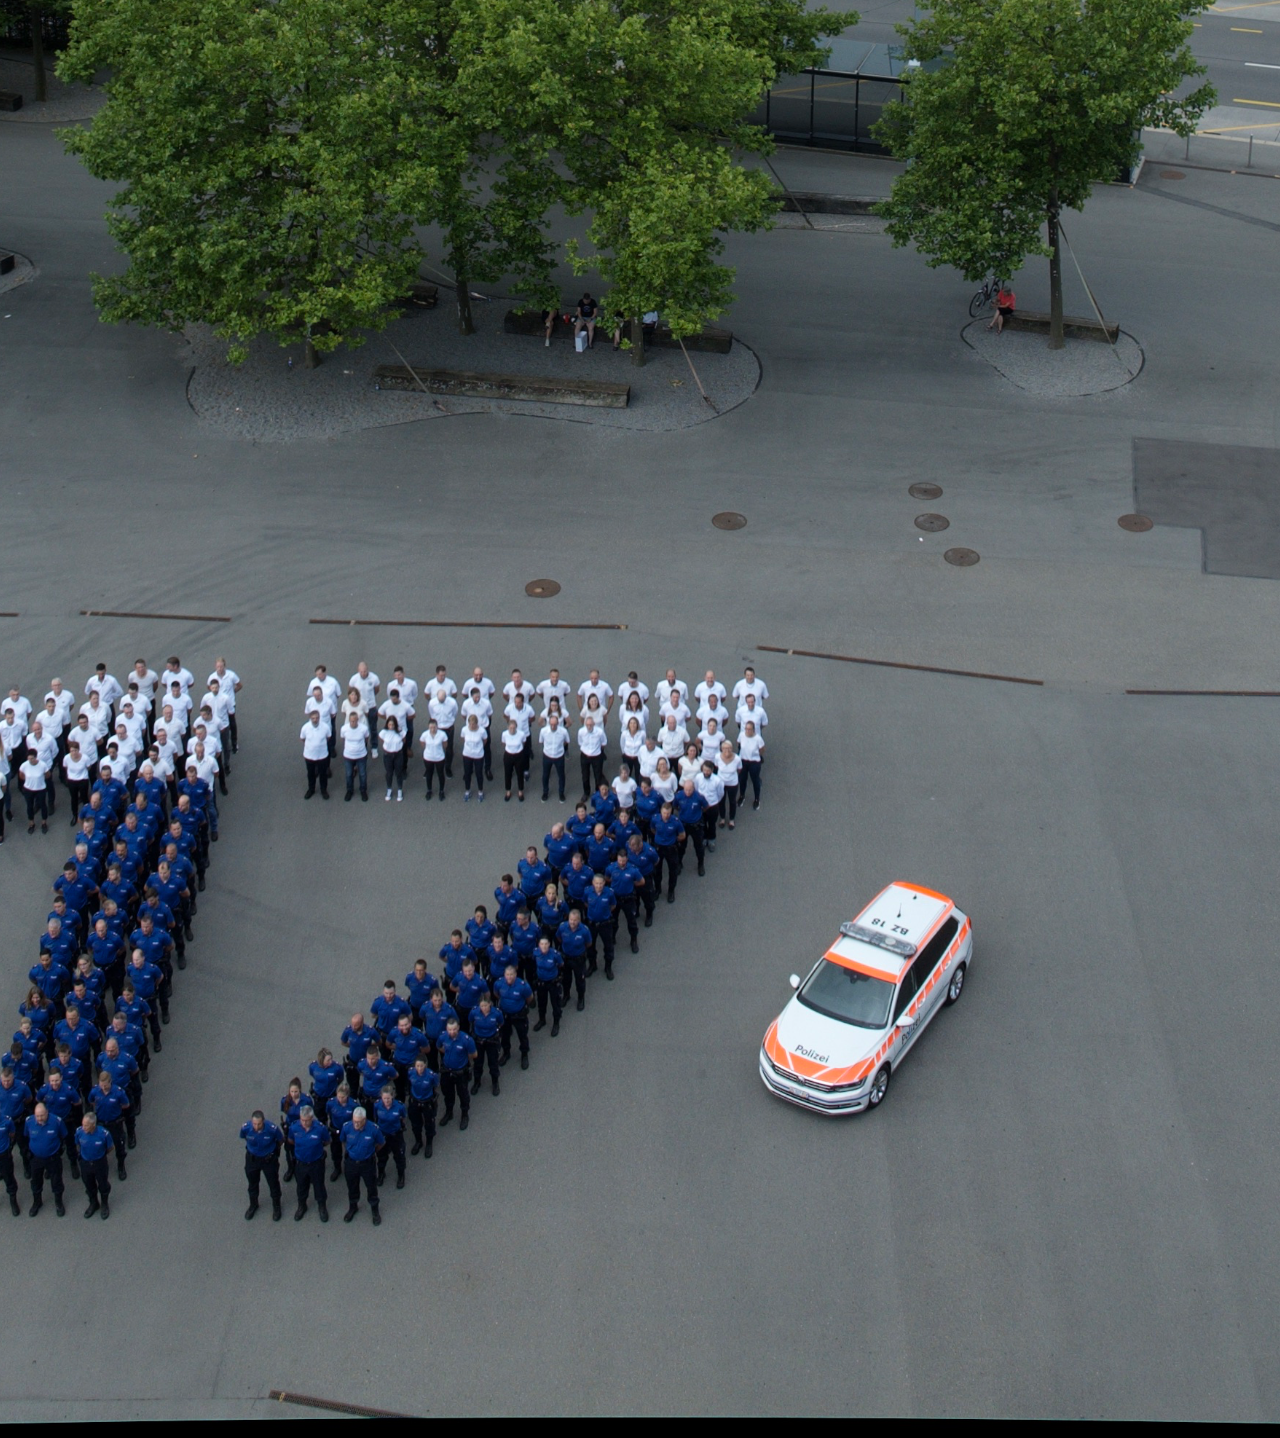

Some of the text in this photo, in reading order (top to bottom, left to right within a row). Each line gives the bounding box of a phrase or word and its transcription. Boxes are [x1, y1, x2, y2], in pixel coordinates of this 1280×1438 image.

[871, 918, 909, 936] BZ 18
[795, 1044, 830, 1064] Polizei
